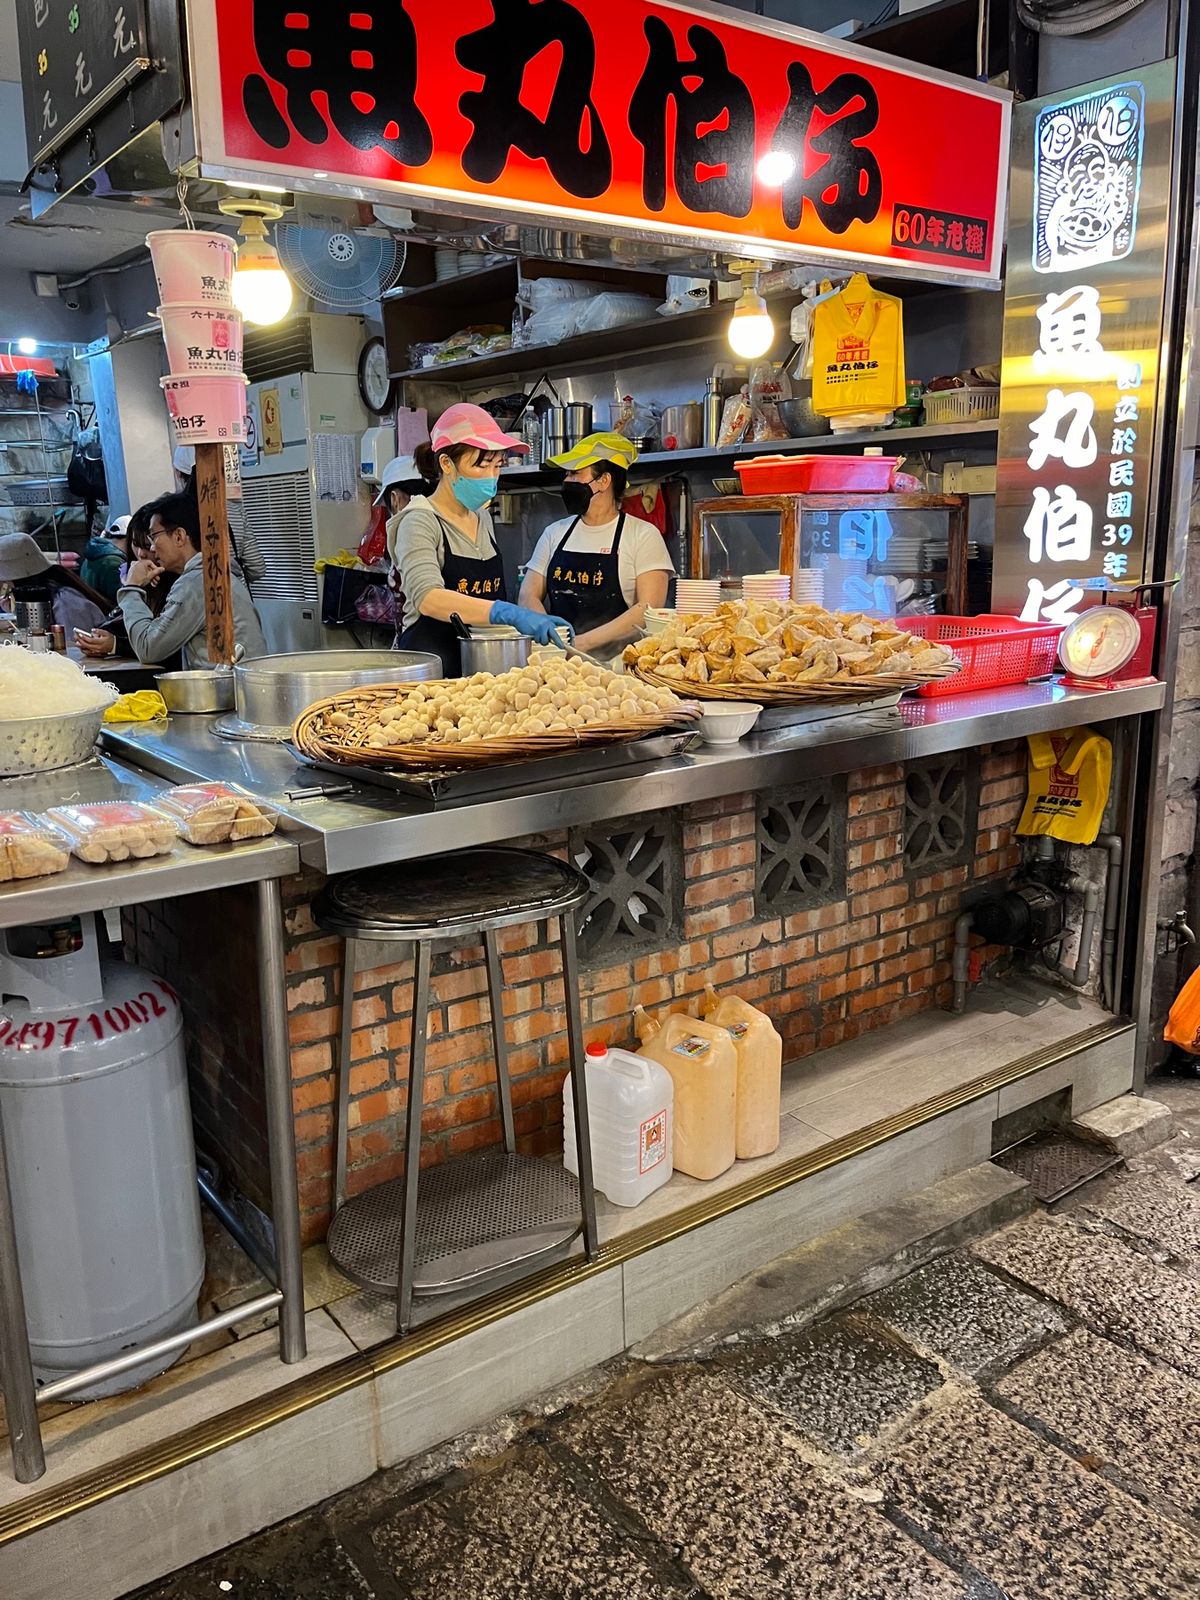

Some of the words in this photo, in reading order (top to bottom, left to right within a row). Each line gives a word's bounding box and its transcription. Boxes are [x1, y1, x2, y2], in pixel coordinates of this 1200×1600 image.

[113, 6, 137, 58] 元
[553, 566, 604, 586] 魚丸伯仔
